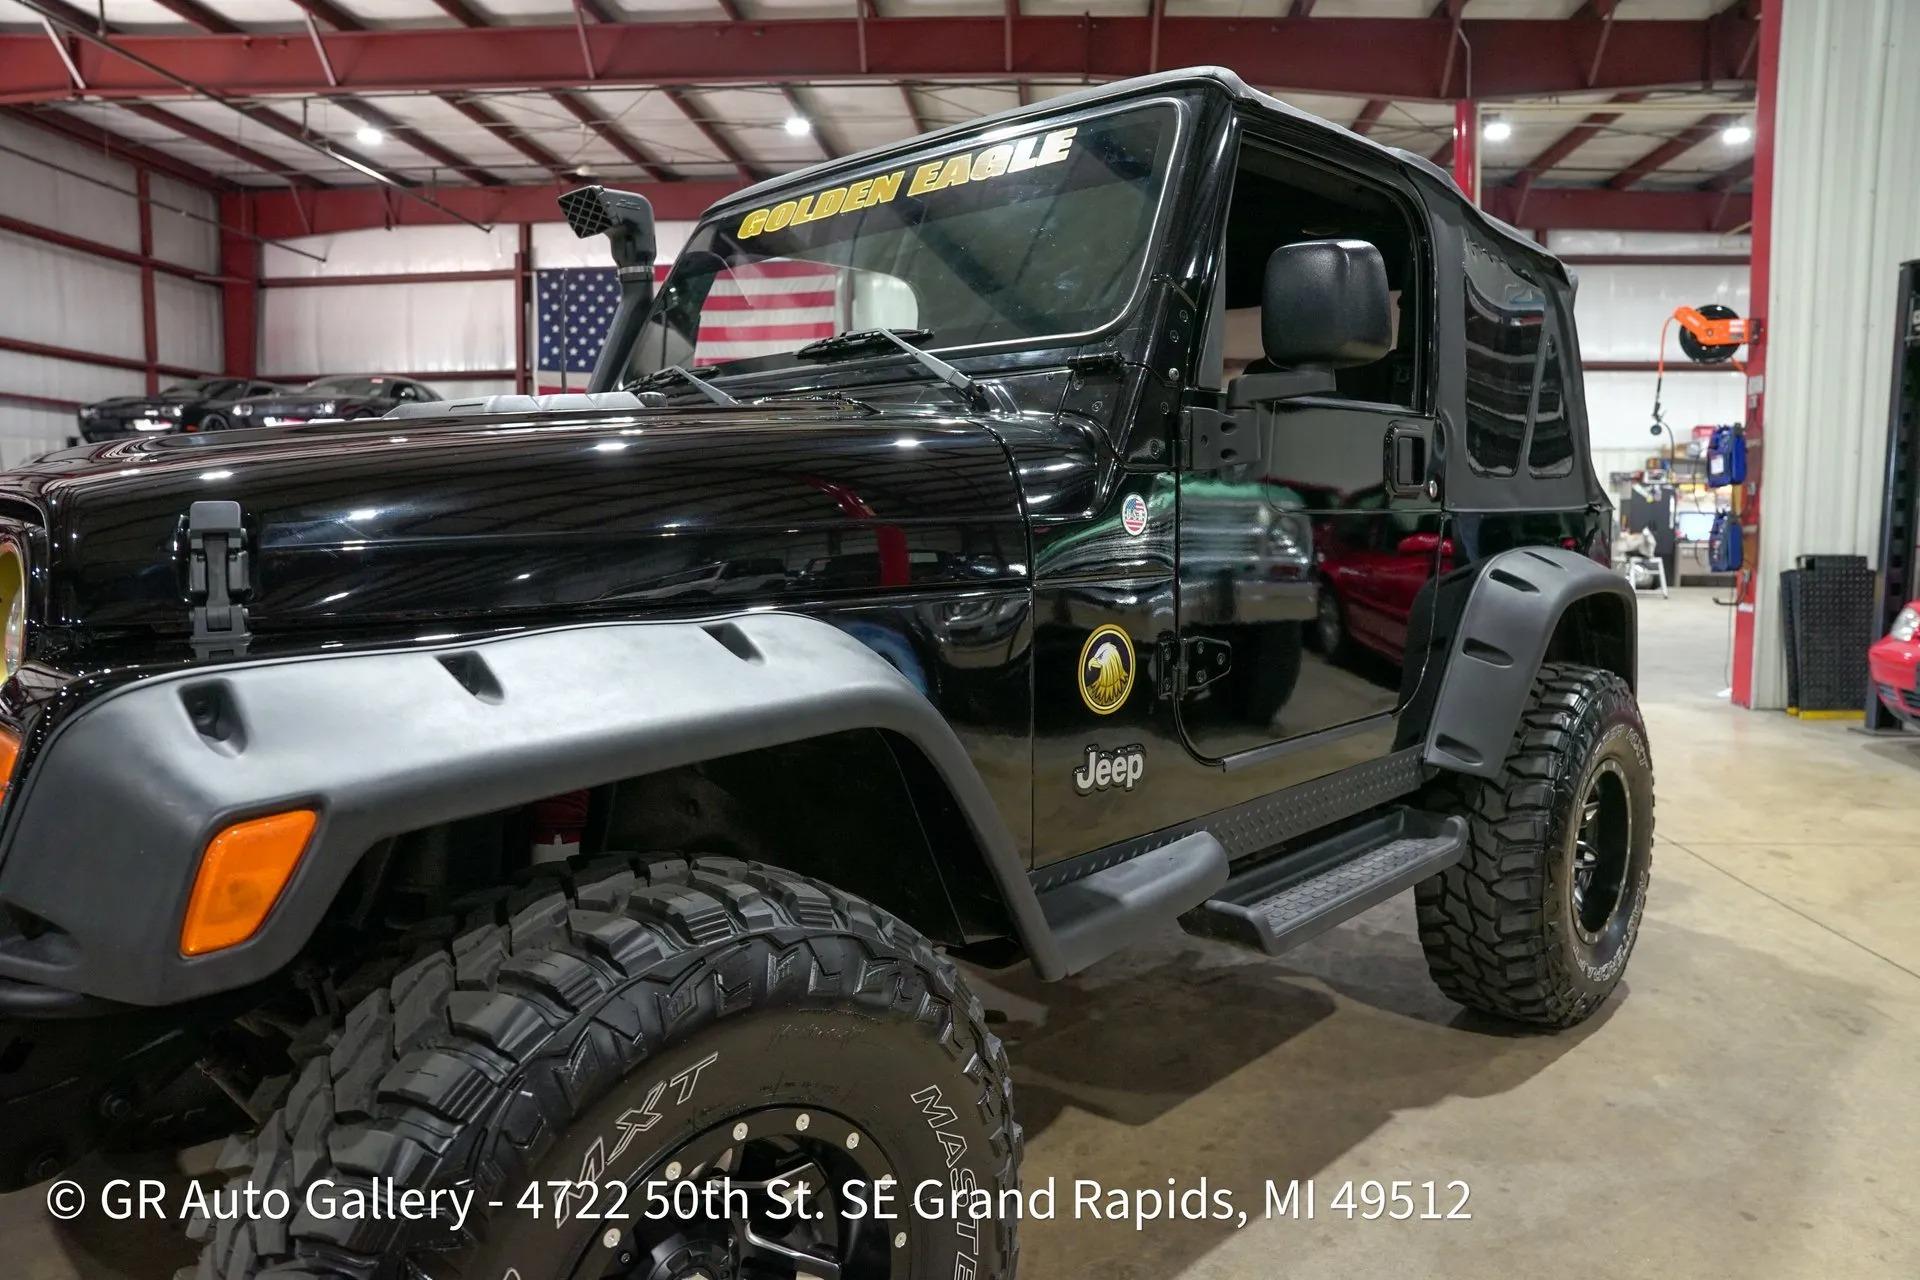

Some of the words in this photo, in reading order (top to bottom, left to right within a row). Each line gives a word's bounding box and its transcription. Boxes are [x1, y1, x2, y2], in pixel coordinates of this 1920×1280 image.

[737, 171, 905, 240] GOLDEN
[907, 127, 1078, 197] EAGLE
[1075, 749, 1144, 790] Jeep
